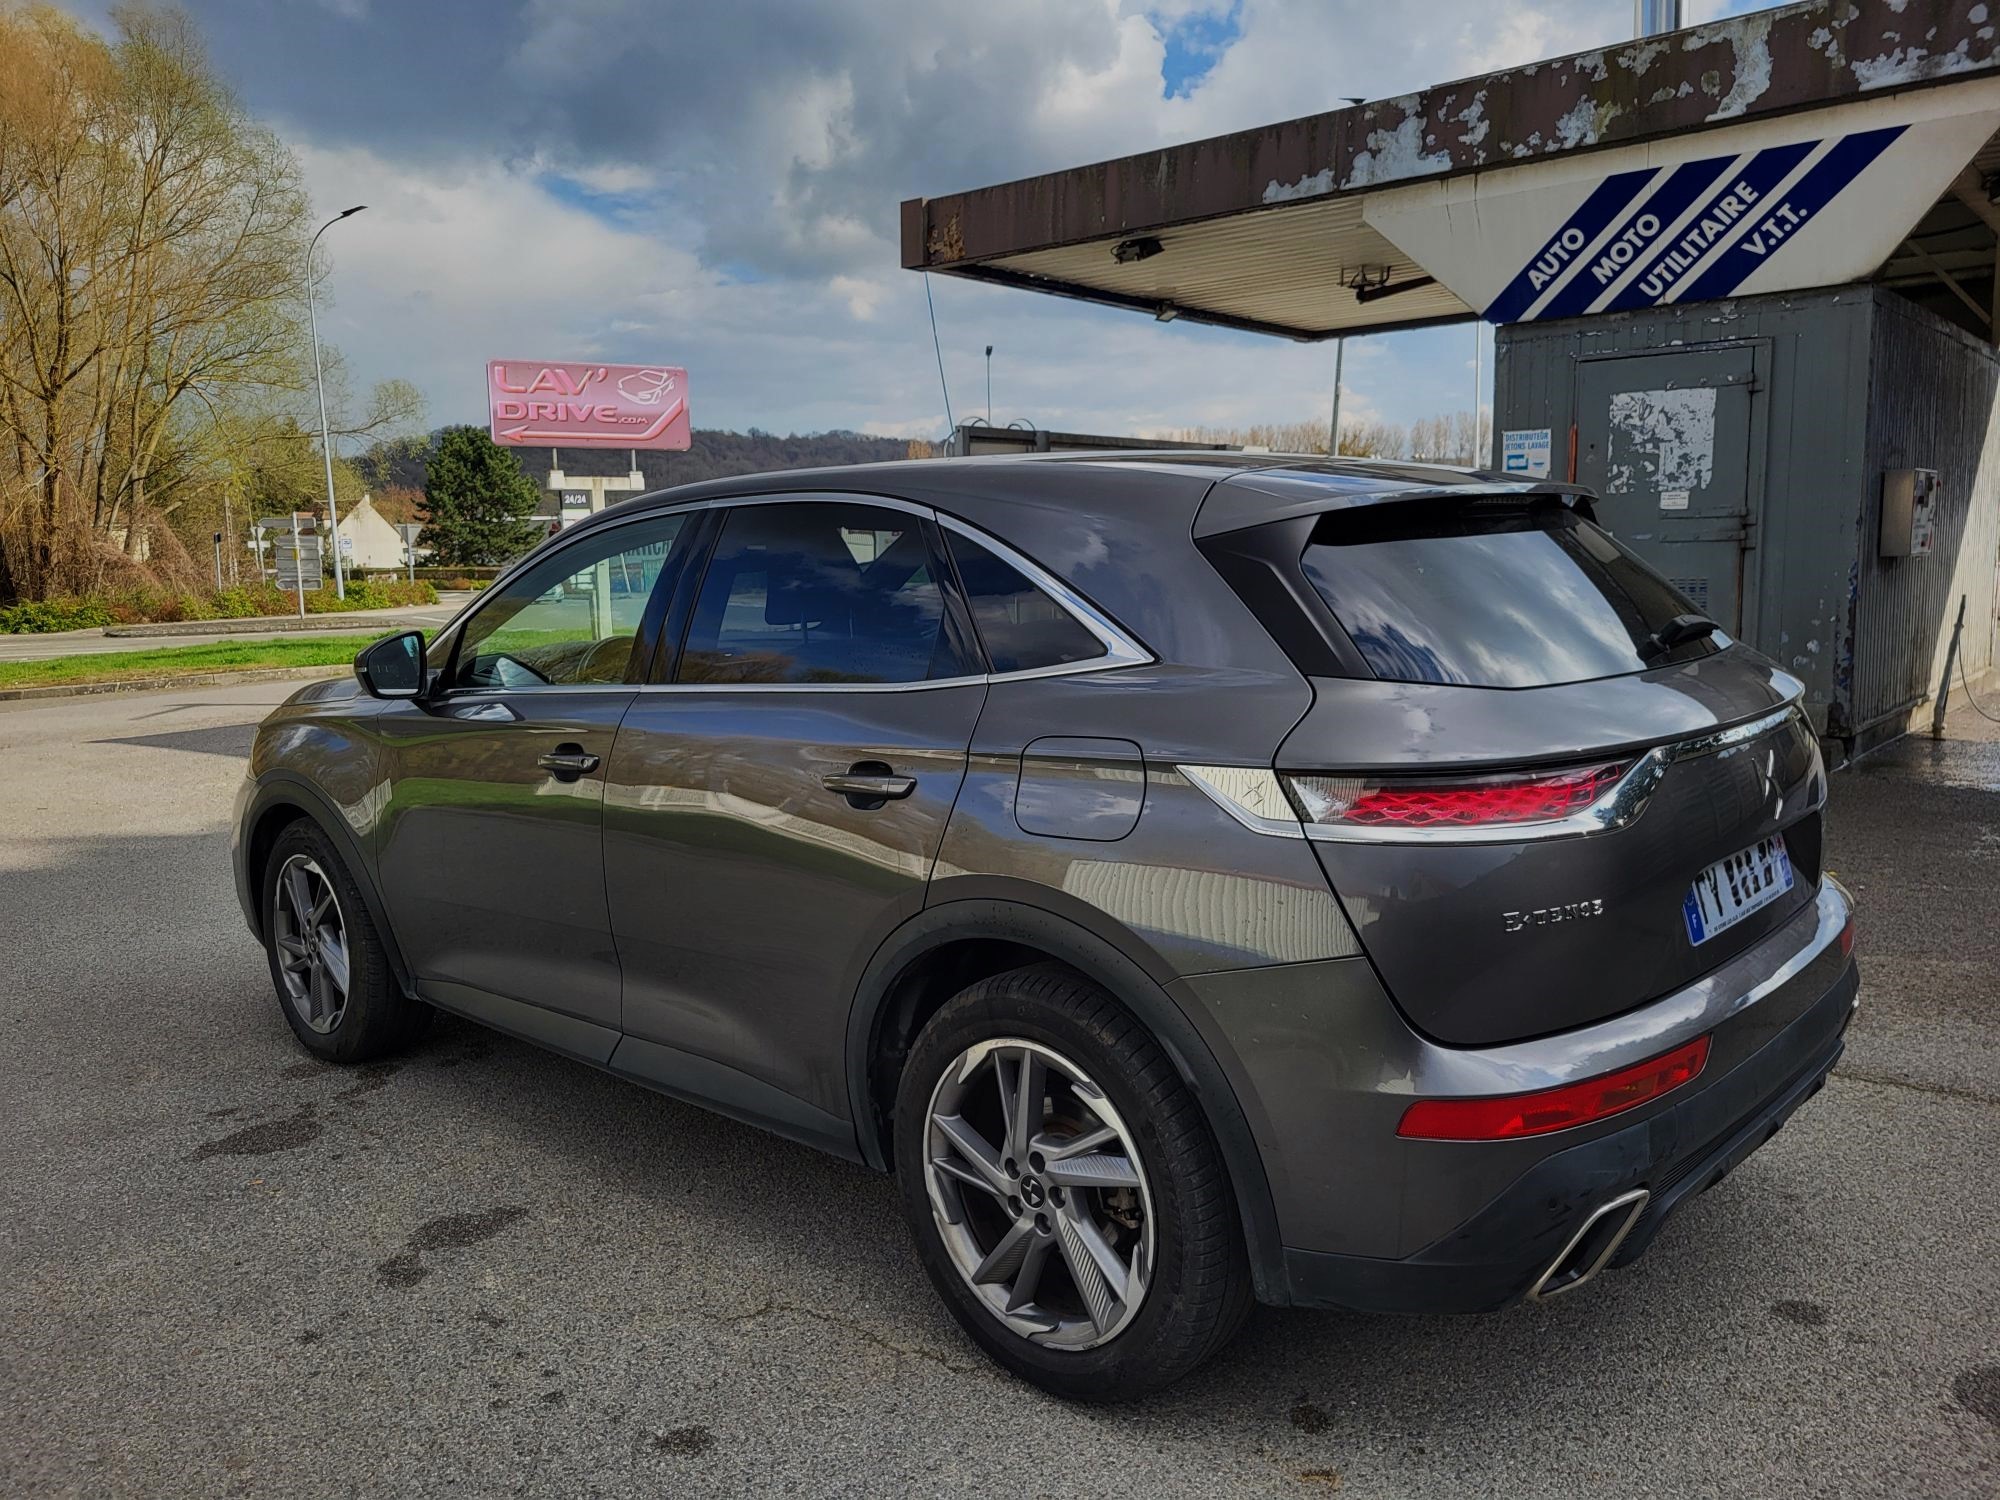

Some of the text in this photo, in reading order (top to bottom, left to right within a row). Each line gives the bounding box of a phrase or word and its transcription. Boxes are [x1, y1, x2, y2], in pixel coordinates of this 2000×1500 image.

[1590, 213, 1661, 286] MOTO
[1637, 180, 1761, 298] UTILITAIRE
[1739, 202, 1809, 257] V.T.T.
[1526, 227, 1586, 292] AUTO
[494, 366, 609, 396] LAV'
[1504, 441, 1550, 451] JETONS LAVAGE
[1505, 432, 1549, 442] DISTRIBUTEUR
[564, 494, 587, 504] 24/24
